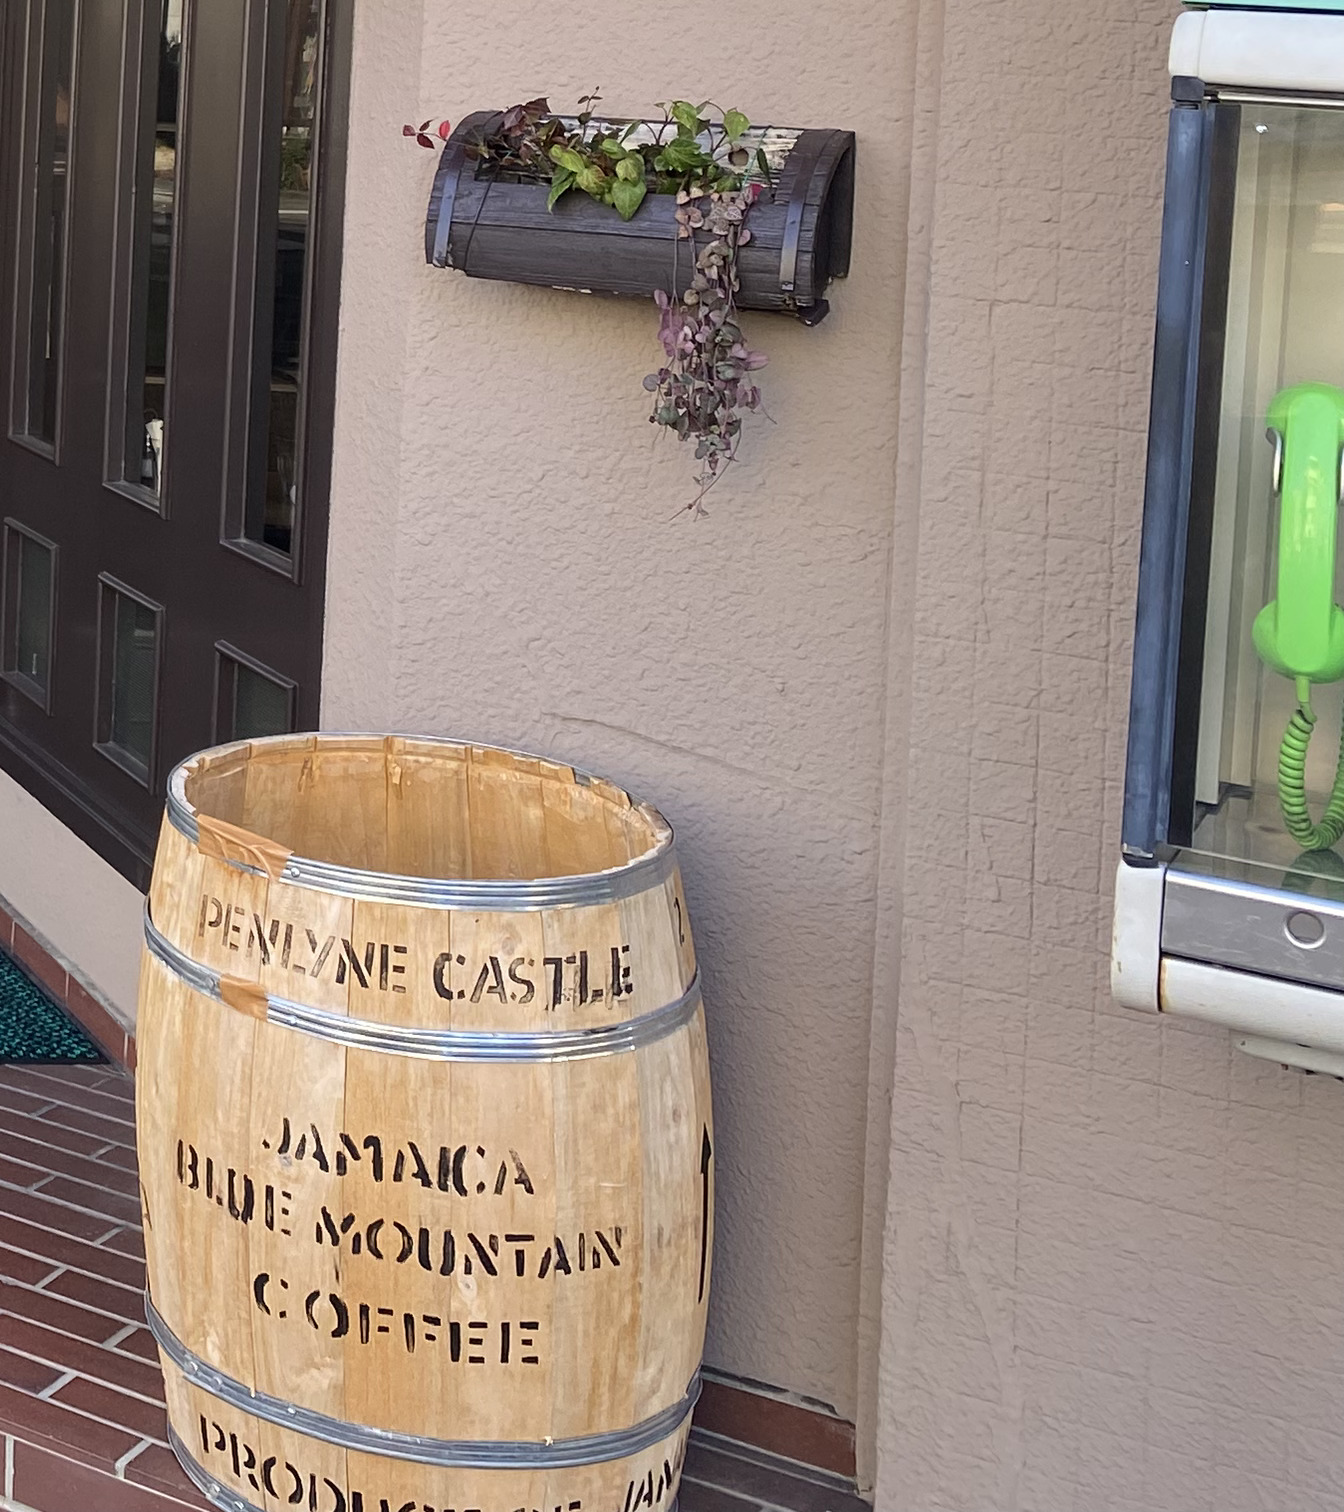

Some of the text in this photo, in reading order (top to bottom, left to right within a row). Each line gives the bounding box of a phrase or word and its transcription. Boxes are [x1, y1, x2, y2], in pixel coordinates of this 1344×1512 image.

[198, 894, 634, 1012] PENLYNE CASTLE
[177, 1139, 624, 1279] BLUE MOUNTAIN
[262, 1118, 535, 1197] JAMAICA
[253, 1272, 540, 1365] COFFEE
